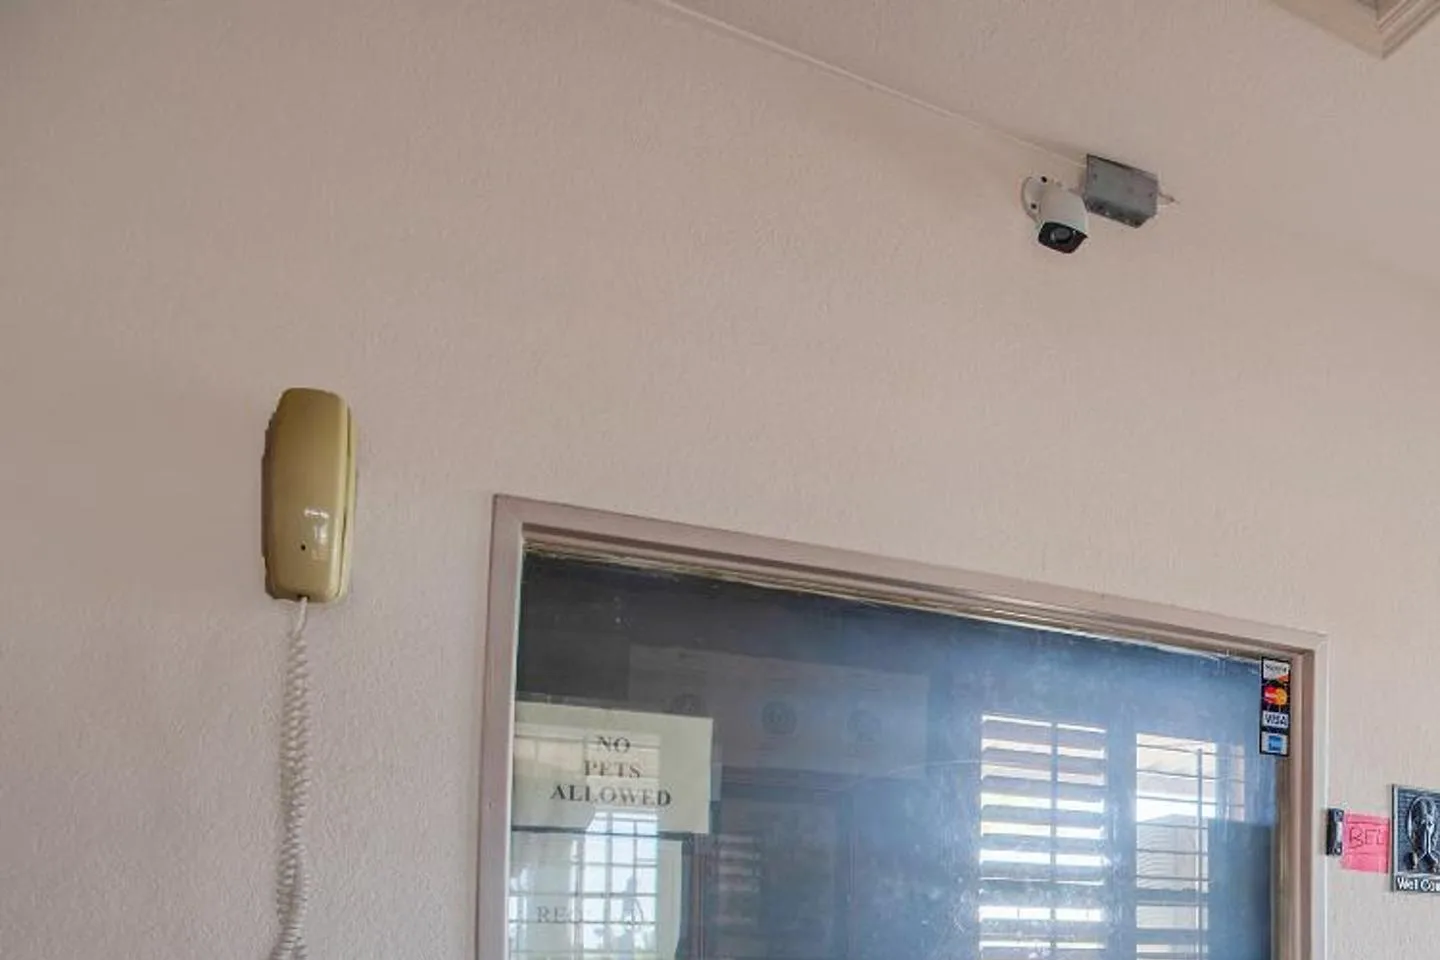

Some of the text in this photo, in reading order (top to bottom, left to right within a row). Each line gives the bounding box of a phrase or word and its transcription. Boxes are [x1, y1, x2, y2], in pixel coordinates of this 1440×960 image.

[596, 735, 631, 753] NO
[584, 760, 641, 779] PETS
[550, 783, 672, 806] ALLOWED
